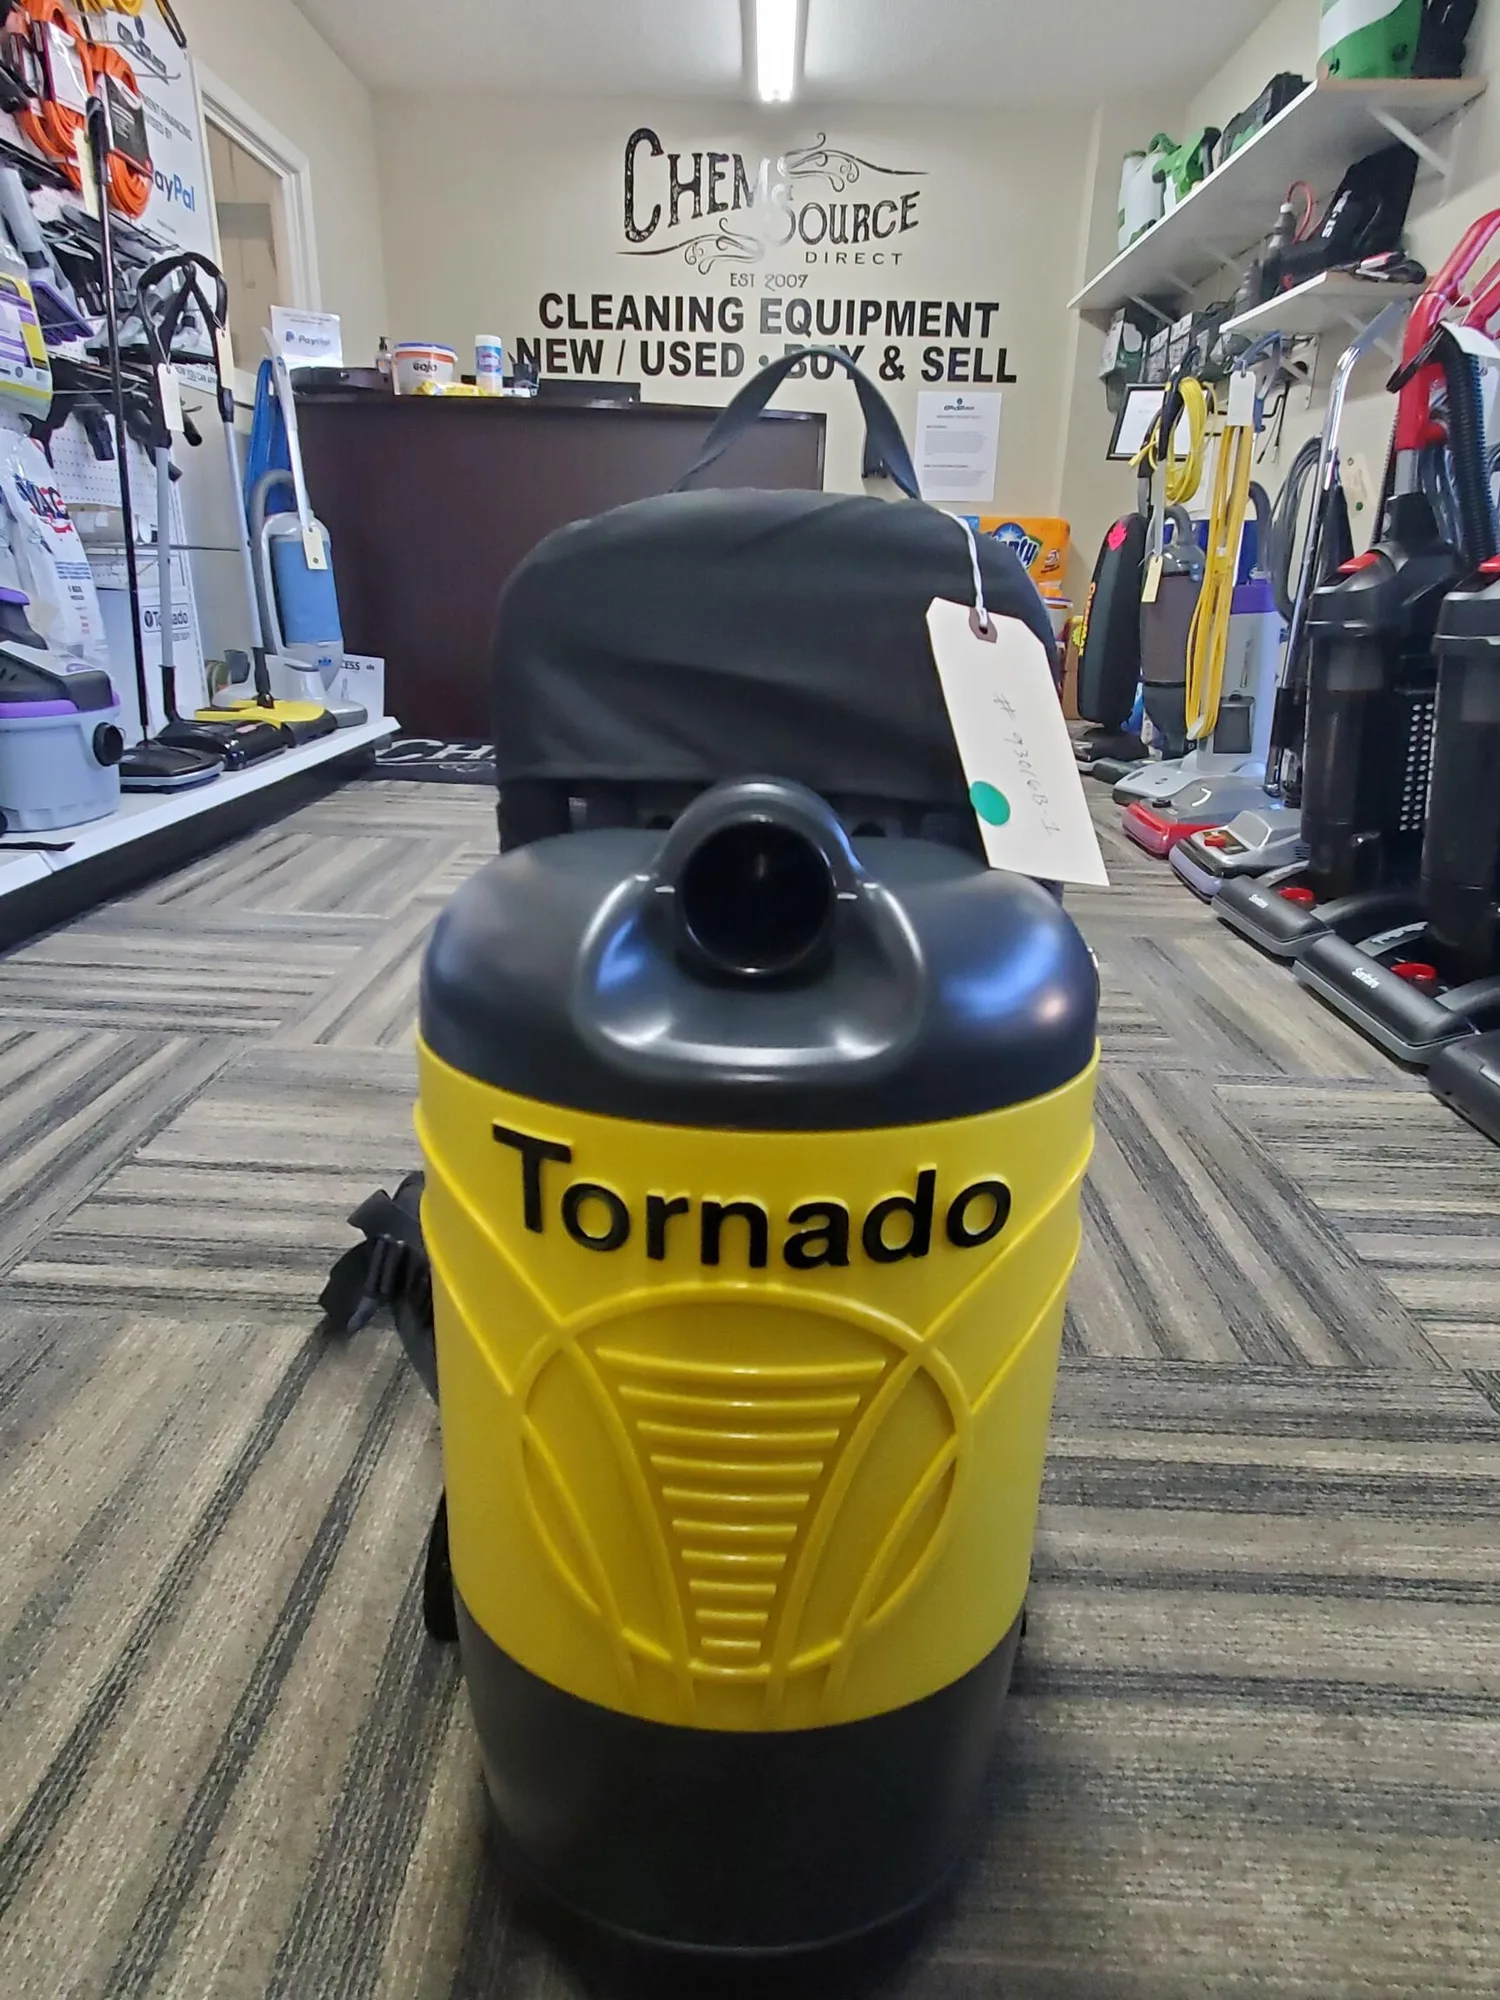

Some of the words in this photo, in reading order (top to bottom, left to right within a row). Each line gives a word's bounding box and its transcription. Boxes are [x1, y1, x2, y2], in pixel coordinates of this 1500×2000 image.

[154, 170, 195, 212] ayPal
[624, 127, 772, 243] CHEM
[768, 184, 920, 246] SOURCE
[730, 272, 755, 287] EST
[805, 251, 903, 265] DIRECT
[539, 293, 744, 333] CLEANING
[759, 298, 1000, 337] EQUIPMENT
[515, 338, 606, 374] NEW
[640, 341, 745, 377] USED
[784, 344, 866, 380] BUY
[878, 345, 906, 381] &
[920, 346, 1017, 383] SELL
[492, 1123, 1012, 1269] Tornado
